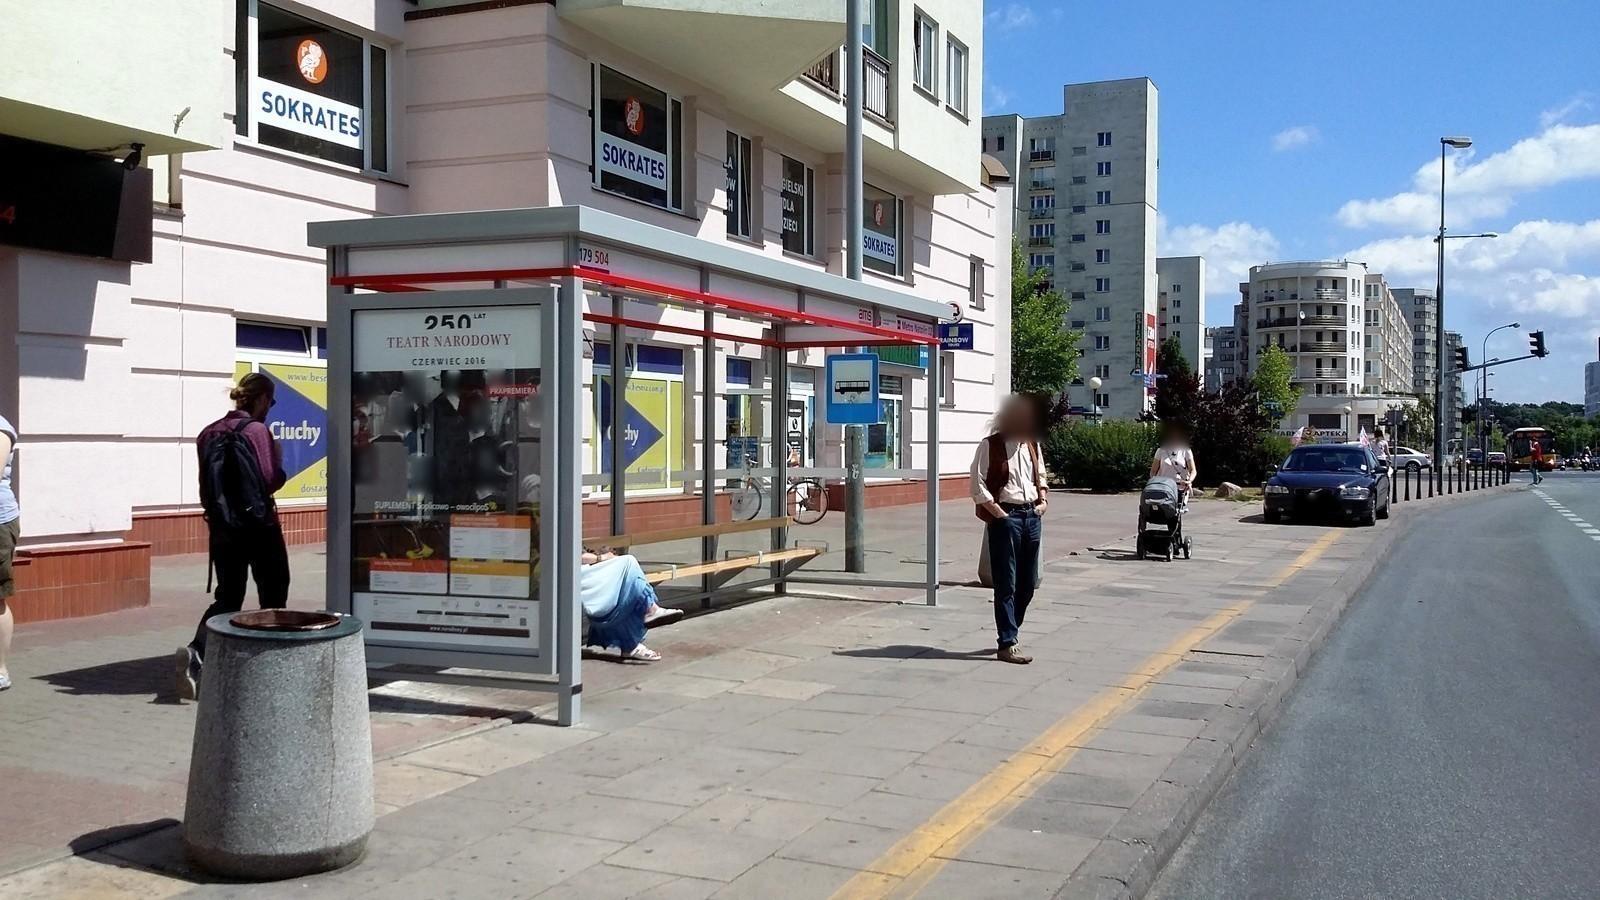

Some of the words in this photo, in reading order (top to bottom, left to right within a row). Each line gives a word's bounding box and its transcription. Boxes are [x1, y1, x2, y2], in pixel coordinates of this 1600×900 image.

[262, 91, 360, 137] SOKRATES
[602, 142, 665, 180] SOKRATES
[781, 178, 804, 197] GIELSKI
[782, 217, 799, 233] ZIECI
[863, 235, 895, 257] SOKRATES
[579, 247, 593, 262] 179
[594, 250, 609, 265] 504
[386, 336, 430, 349] TEATR
[433, 333, 512, 348] NARODOWY
[939, 336, 969, 345] RAINBOW
[411, 357, 461, 366] CZERWIEC
[465, 357, 486, 365] 2016
[269, 420, 321, 447] Ciuchy
[1314, 429, 1348, 438] APTEKA
[374, 500, 416, 511] SUPLEMENT
